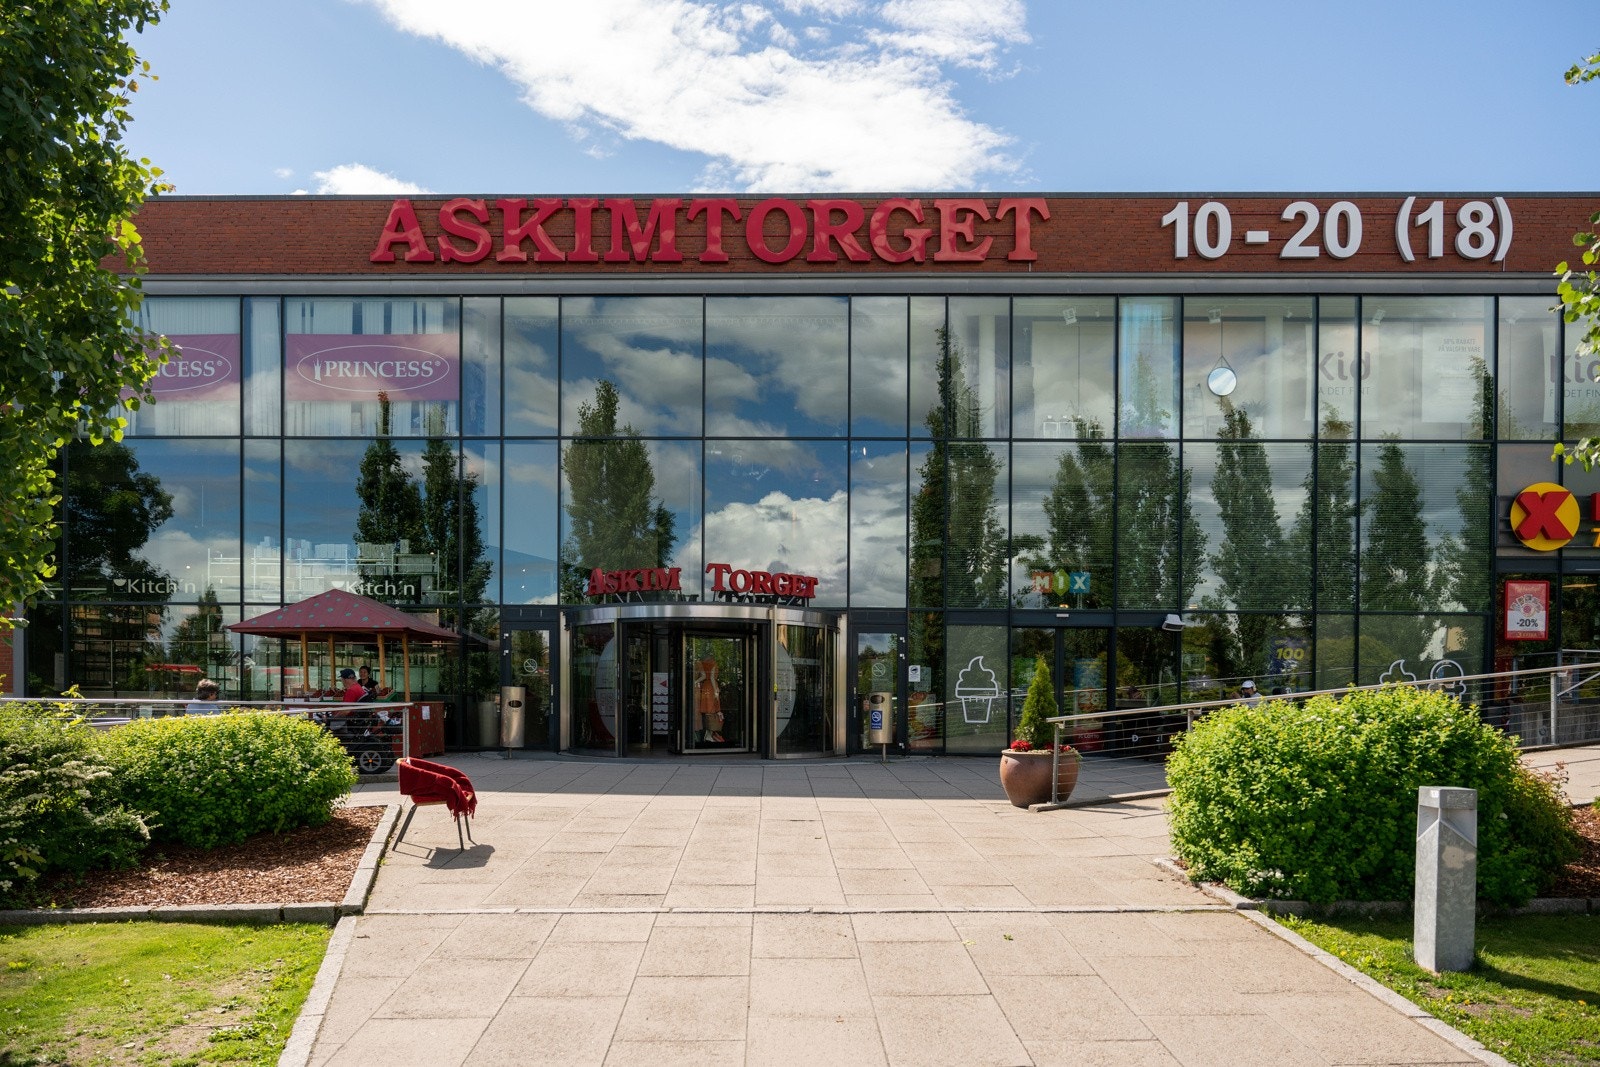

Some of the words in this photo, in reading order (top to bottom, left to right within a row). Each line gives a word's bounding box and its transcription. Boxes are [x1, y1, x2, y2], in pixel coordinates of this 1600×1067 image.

[369, 197, 1051, 264] ASKIMTORGET
[1395, 196, 1514, 263] (18)
[1035, 575, 1087, 590] MIX
[1516, 618, 1539, 628] -20%
[1276, 647, 1305, 661] 100
